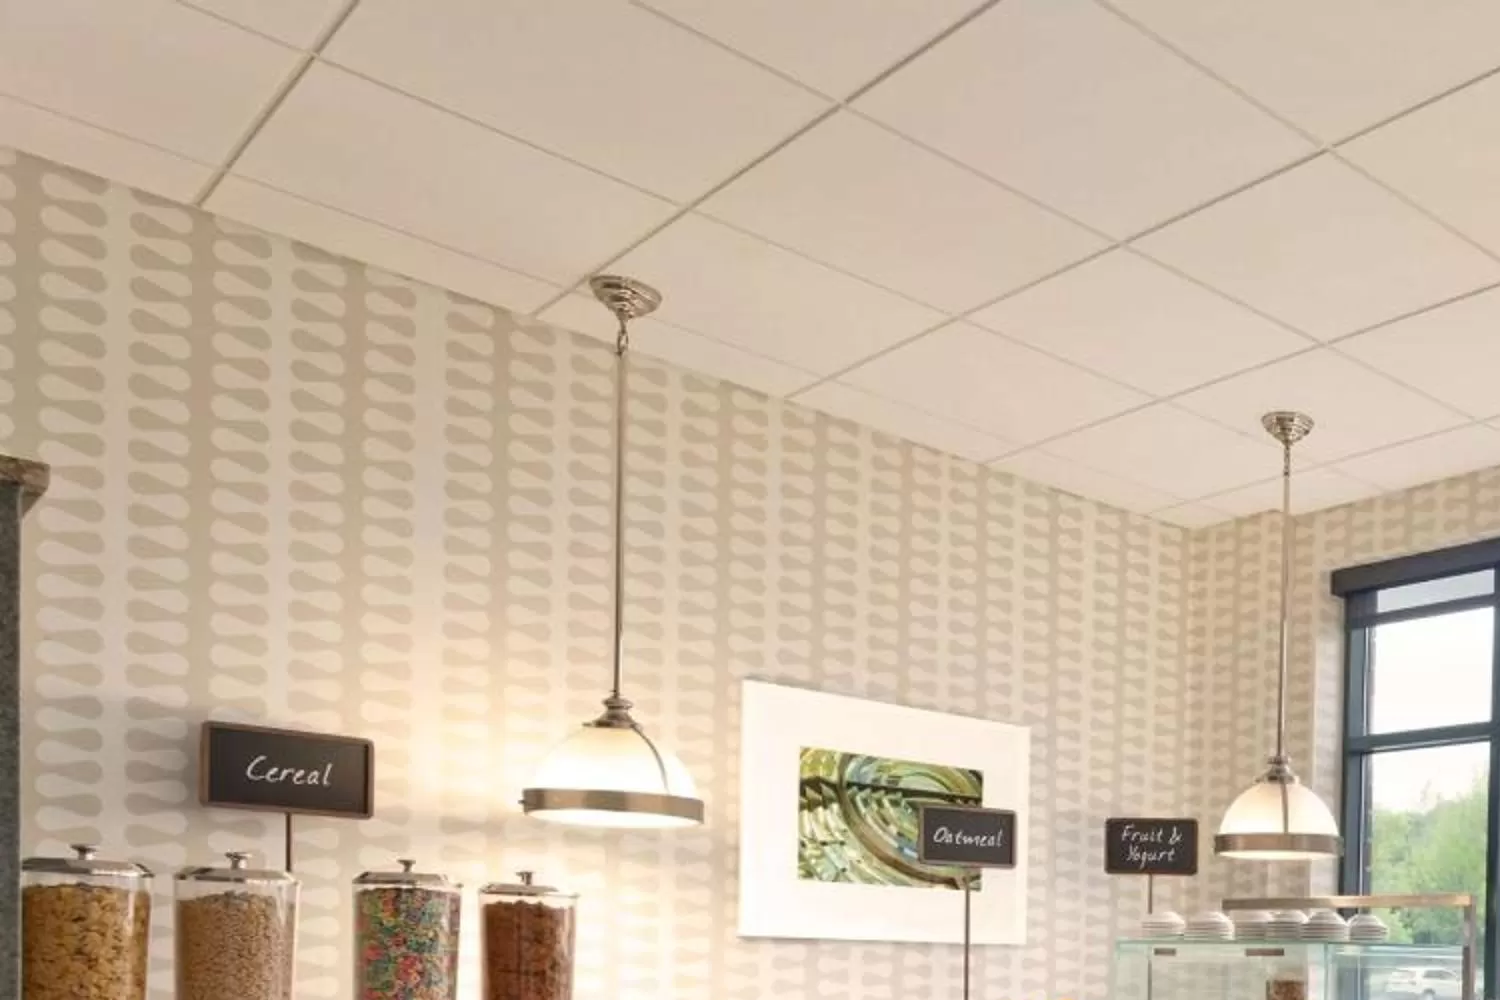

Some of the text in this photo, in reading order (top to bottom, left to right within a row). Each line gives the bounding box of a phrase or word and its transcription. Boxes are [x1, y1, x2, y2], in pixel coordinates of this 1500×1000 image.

[246, 754, 333, 787] Cereal
[933, 826, 1004, 848] Oatmeal
[1121, 823, 1183, 846] Fruit &
[1125, 844, 1176, 870] Yogurt
